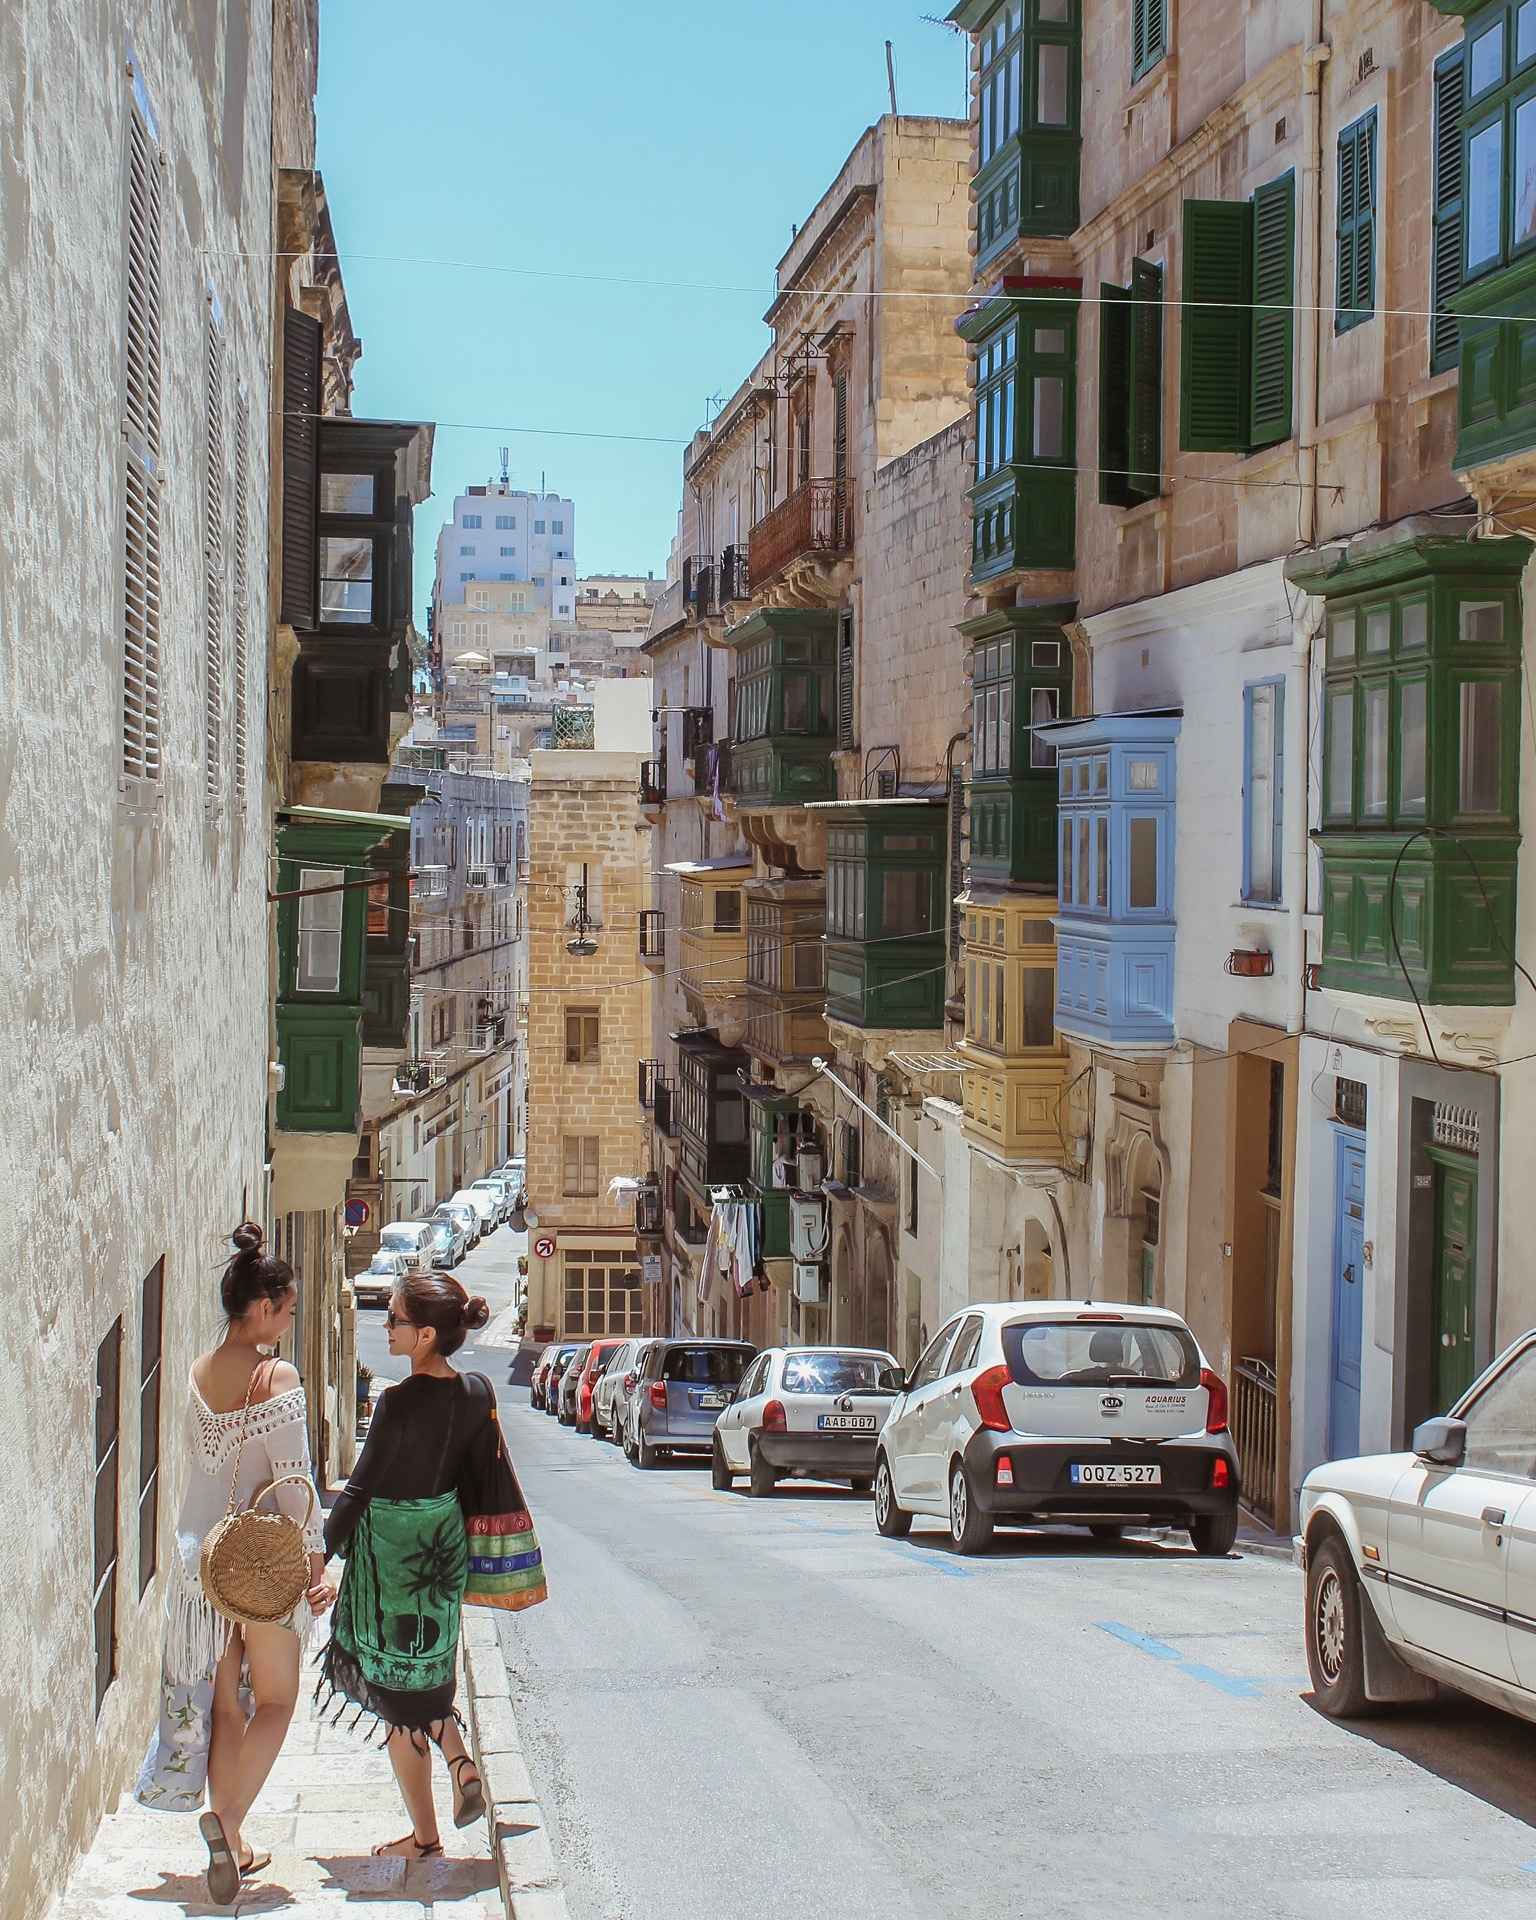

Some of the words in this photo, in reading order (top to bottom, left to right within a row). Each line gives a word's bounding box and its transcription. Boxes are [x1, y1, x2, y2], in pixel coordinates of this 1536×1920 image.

[1103, 1399, 1121, 1407] KIA
[1083, 1466, 1117, 1482] OQZ
[1123, 1467, 1155, 1482] 527
